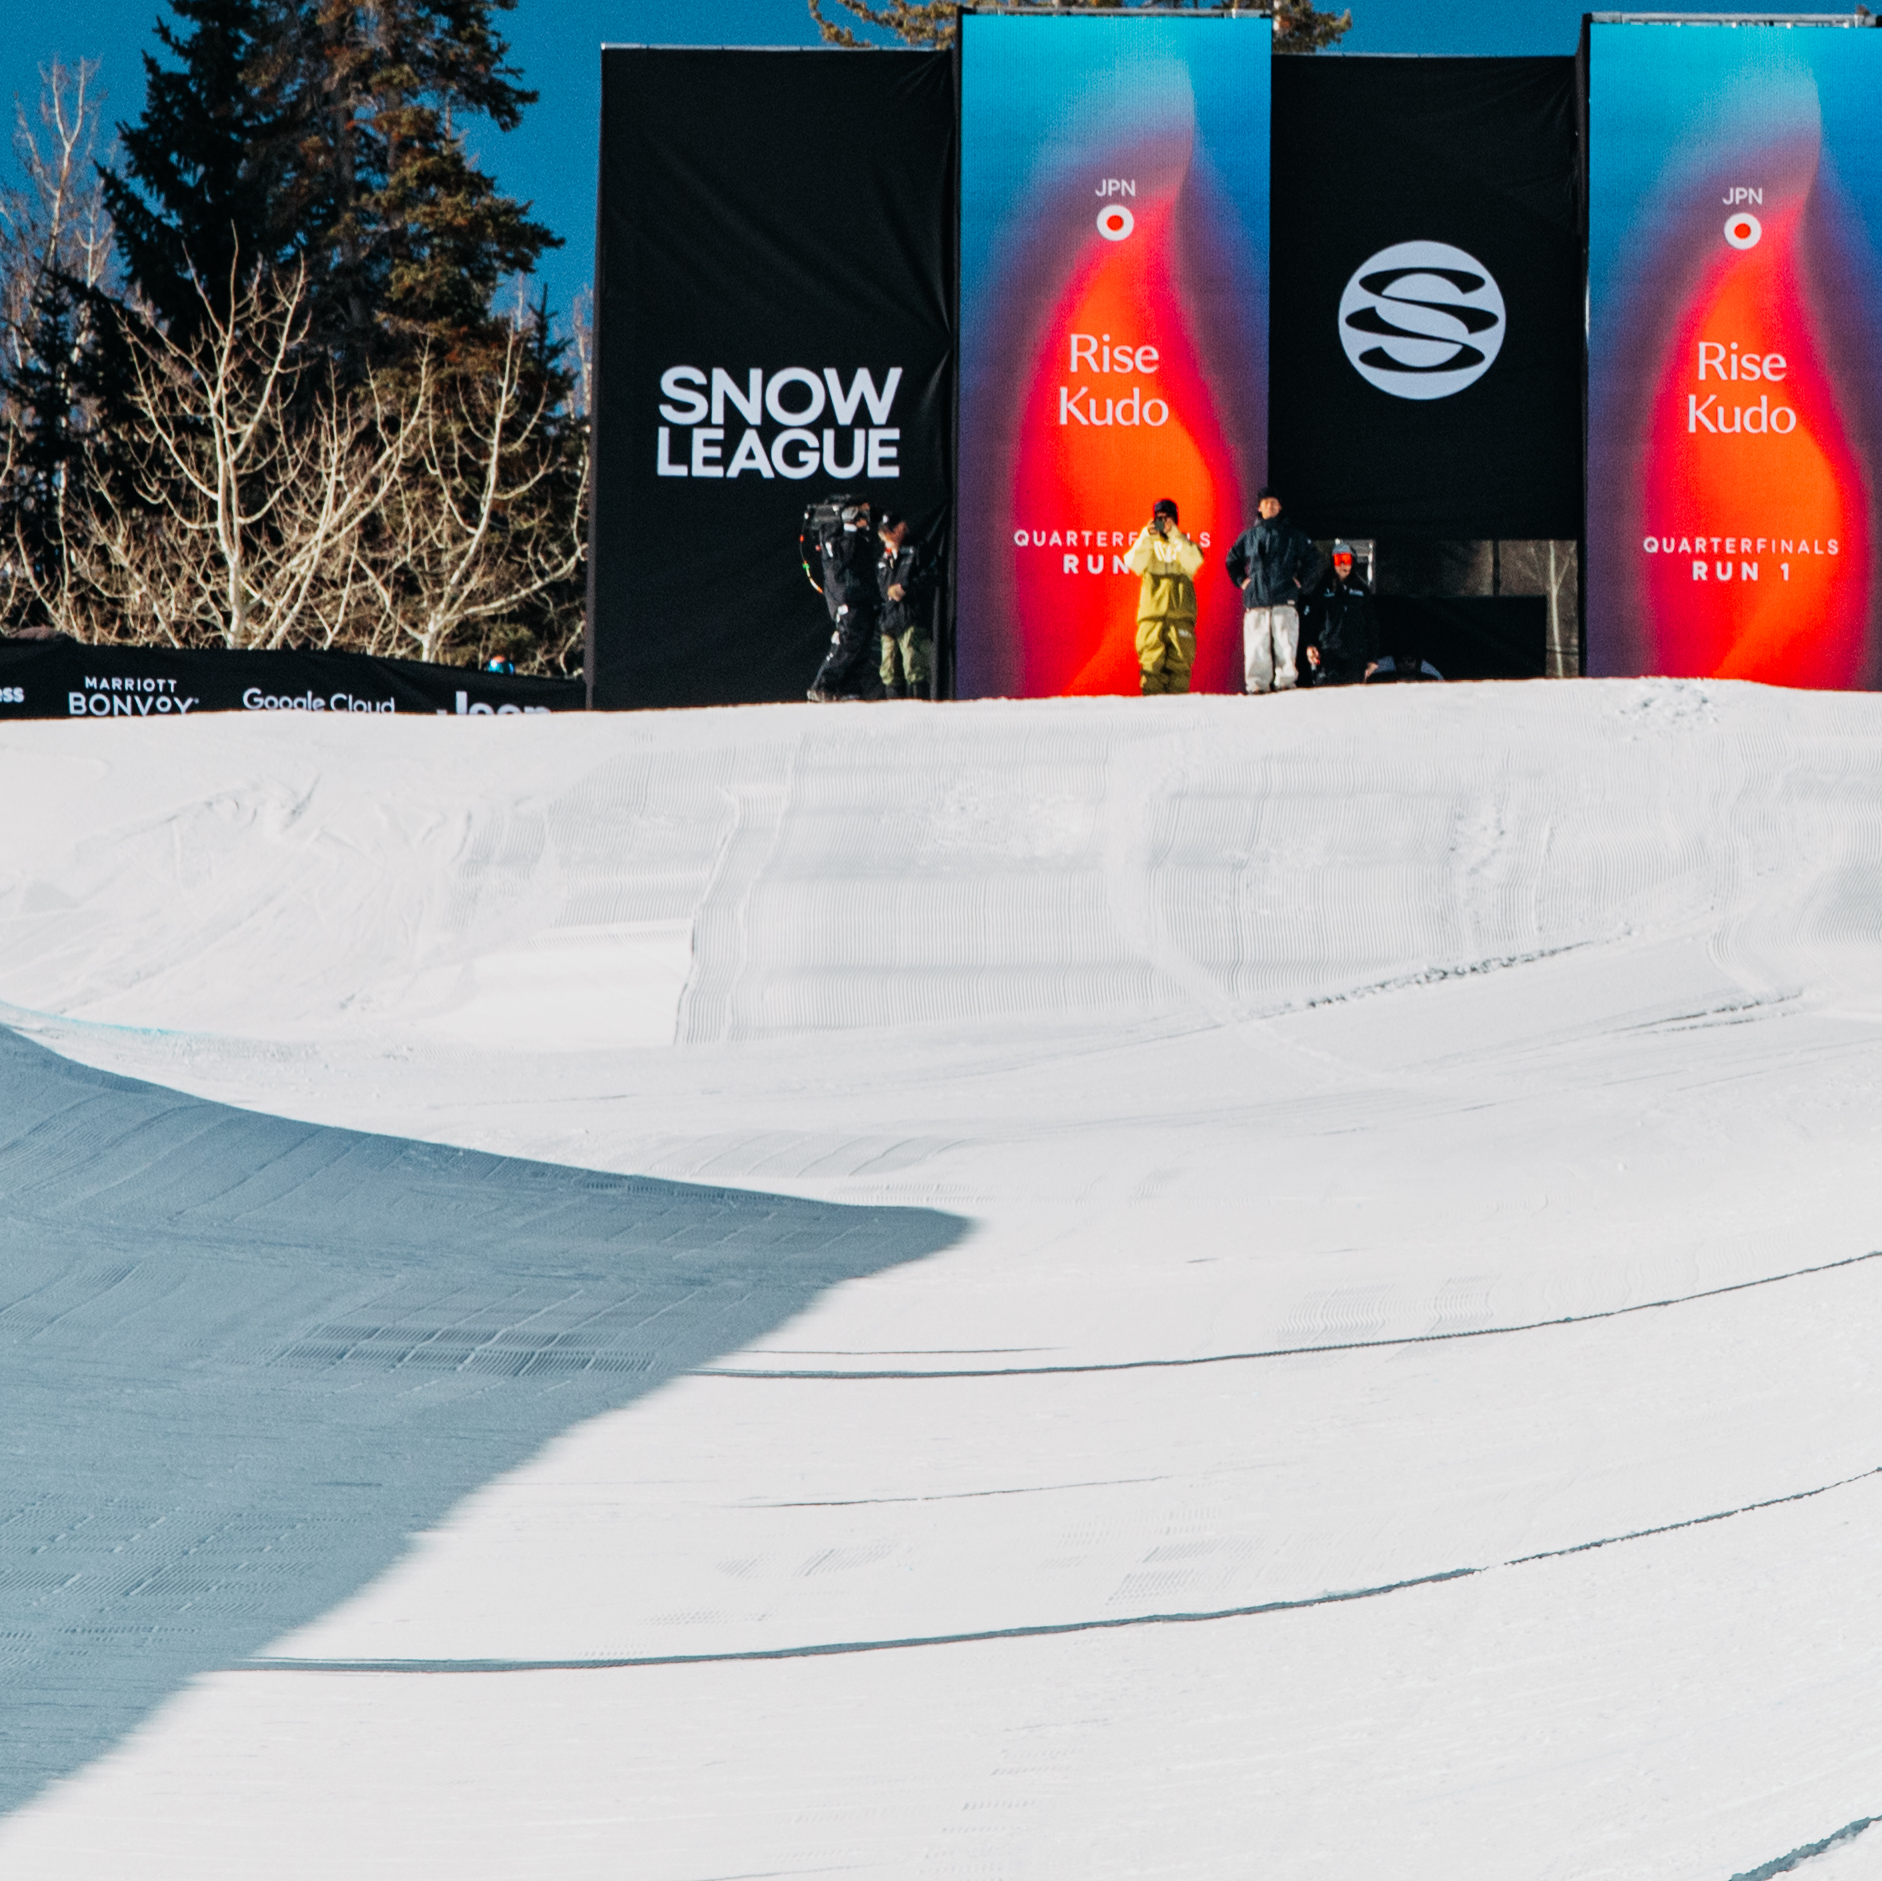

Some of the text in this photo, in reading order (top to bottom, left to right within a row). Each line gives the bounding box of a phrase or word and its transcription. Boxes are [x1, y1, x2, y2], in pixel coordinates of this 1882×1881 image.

[1095, 178, 1137, 198] JPN
[1722, 186, 1764, 205] JPN
[1069, 333, 1160, 374] Rise
[1697, 341, 1788, 382] Rise
[658, 365, 902, 426] SNOW
[1058, 385, 1170, 427] Kudo
[1687, 393, 1798, 435] Kudo
[656, 428, 901, 479] LEAGUE
[1013, 529, 1212, 548] QUARTERFS
[1643, 535, 1839, 556] QUARTERFINALS
[1063, 553, 1130, 575] RUN
[1691, 561, 1790, 582] RUN 1
[85, 676, 177, 693] MARRIOTT
[68, 692, 194, 716] BONVOY
[330, 693, 395, 713] Cloud
